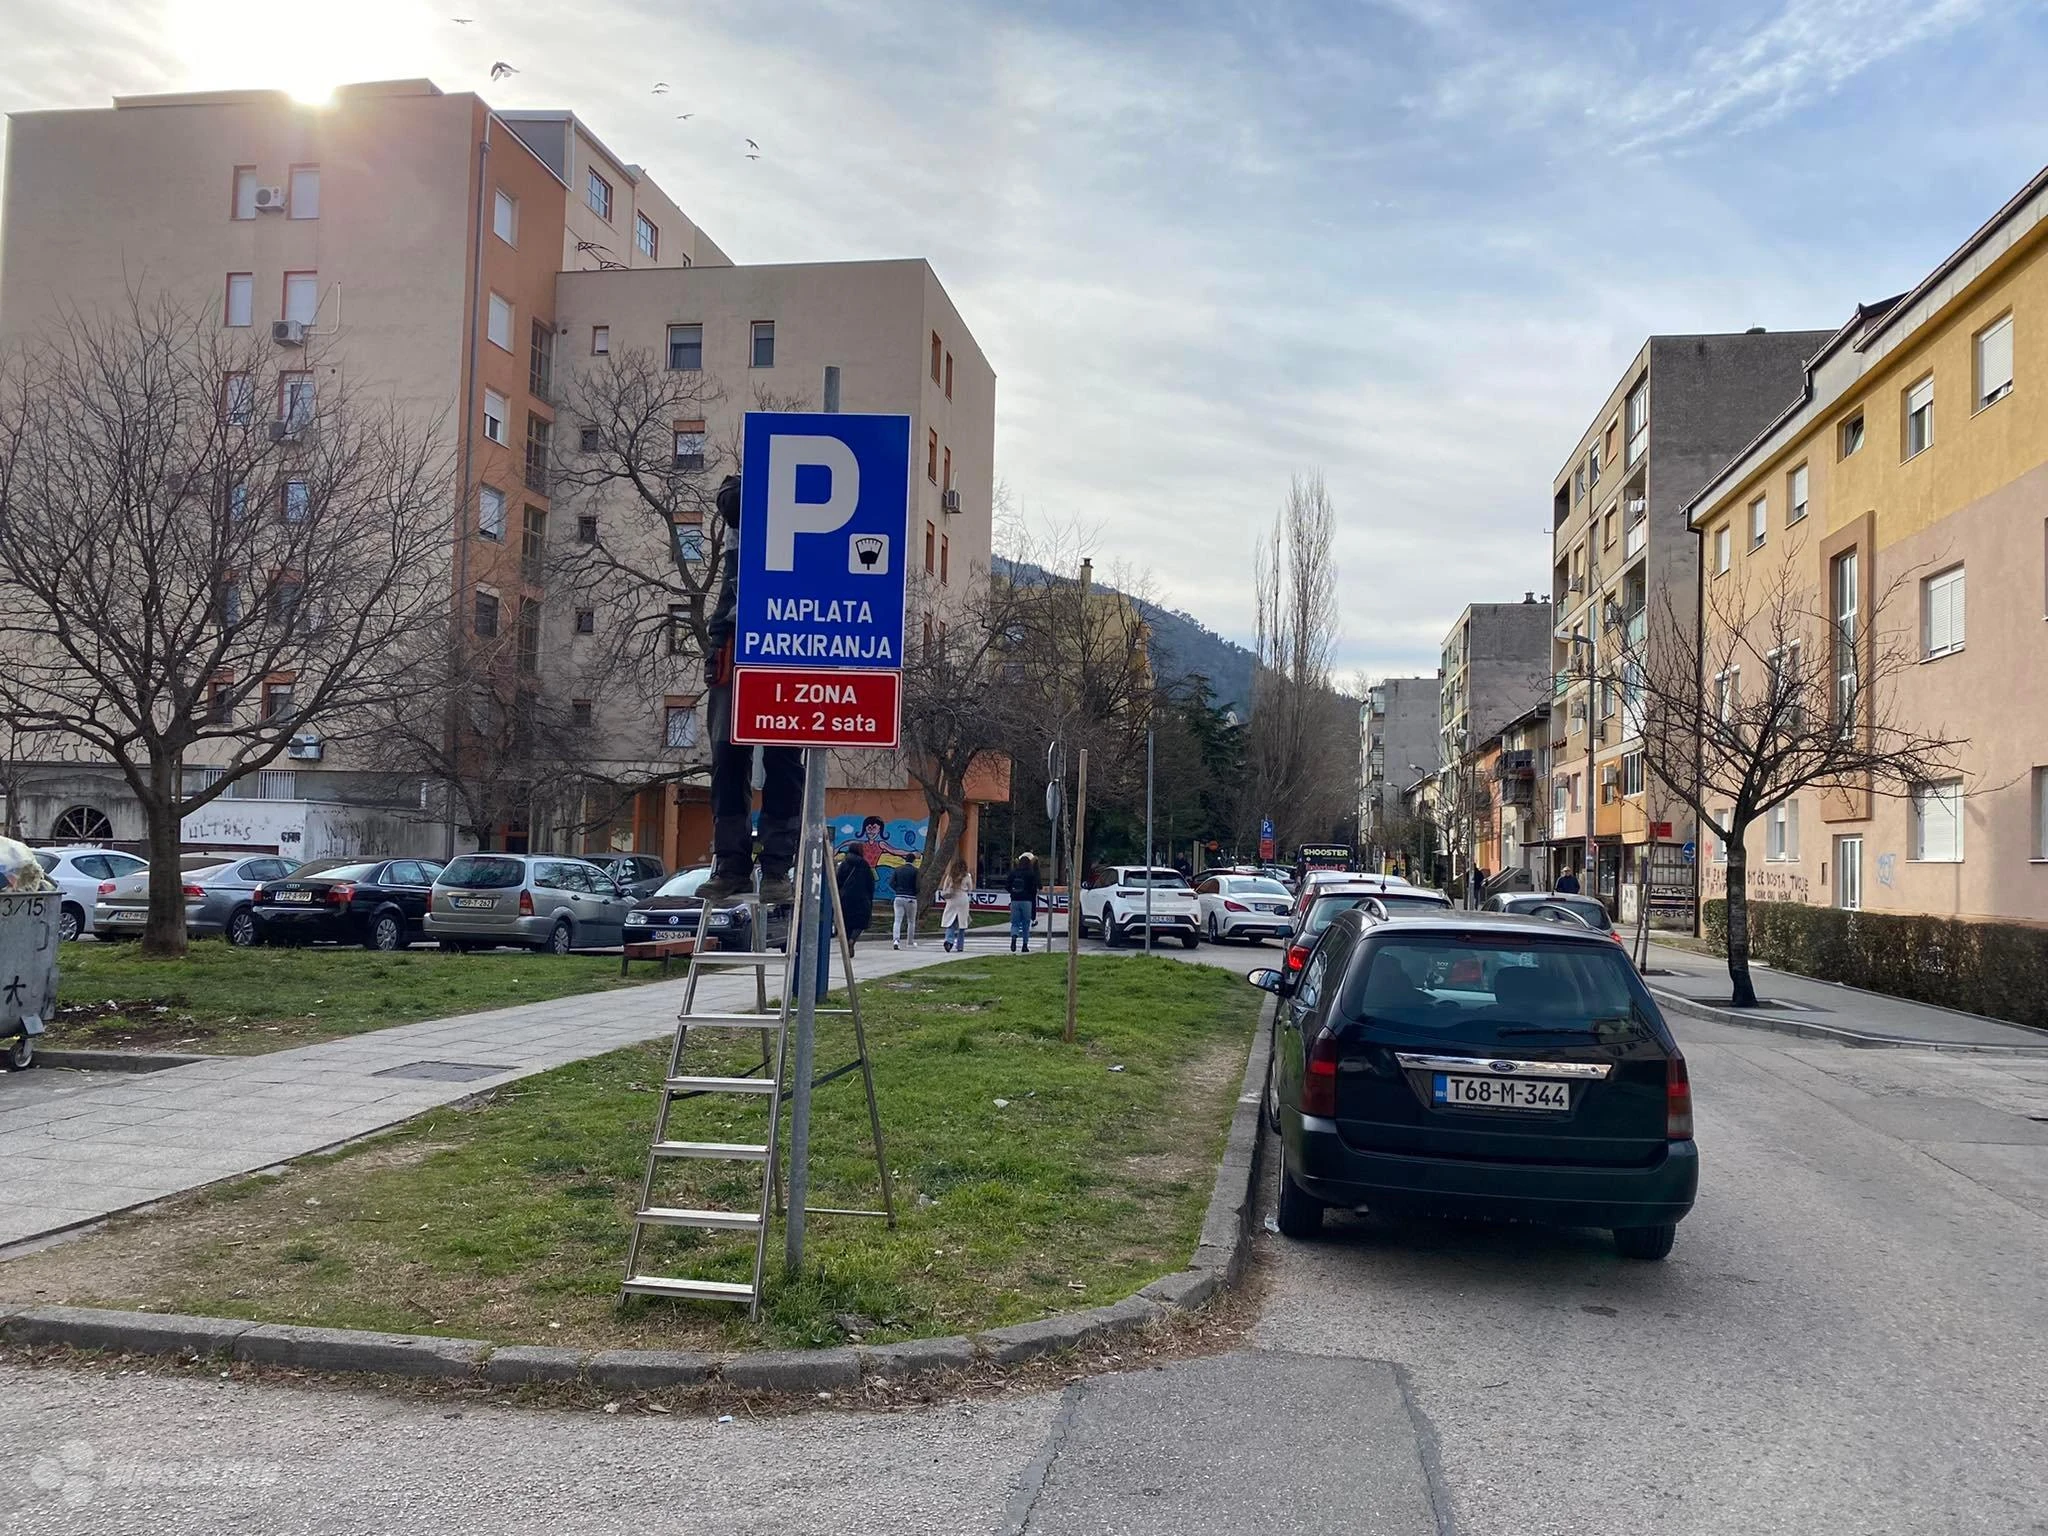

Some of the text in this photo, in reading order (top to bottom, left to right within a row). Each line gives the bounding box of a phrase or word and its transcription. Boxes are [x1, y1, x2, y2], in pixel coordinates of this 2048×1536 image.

[764, 434, 860, 572] P
[767, 598, 873, 624] NAPLATA
[745, 632, 892, 659] PARKIRANJA
[775, 683, 857, 705] I. ZONA
[755, 712, 877, 733] max. 2 sata
[189, 822, 251, 841] ULTRAS
[1263, 821, 1269, 832] P
[1303, 848, 1348, 857] SHOOSTER
[2, 897, 44, 917] 3/15
[1450, 1078, 1565, 1107] T68-M-344
